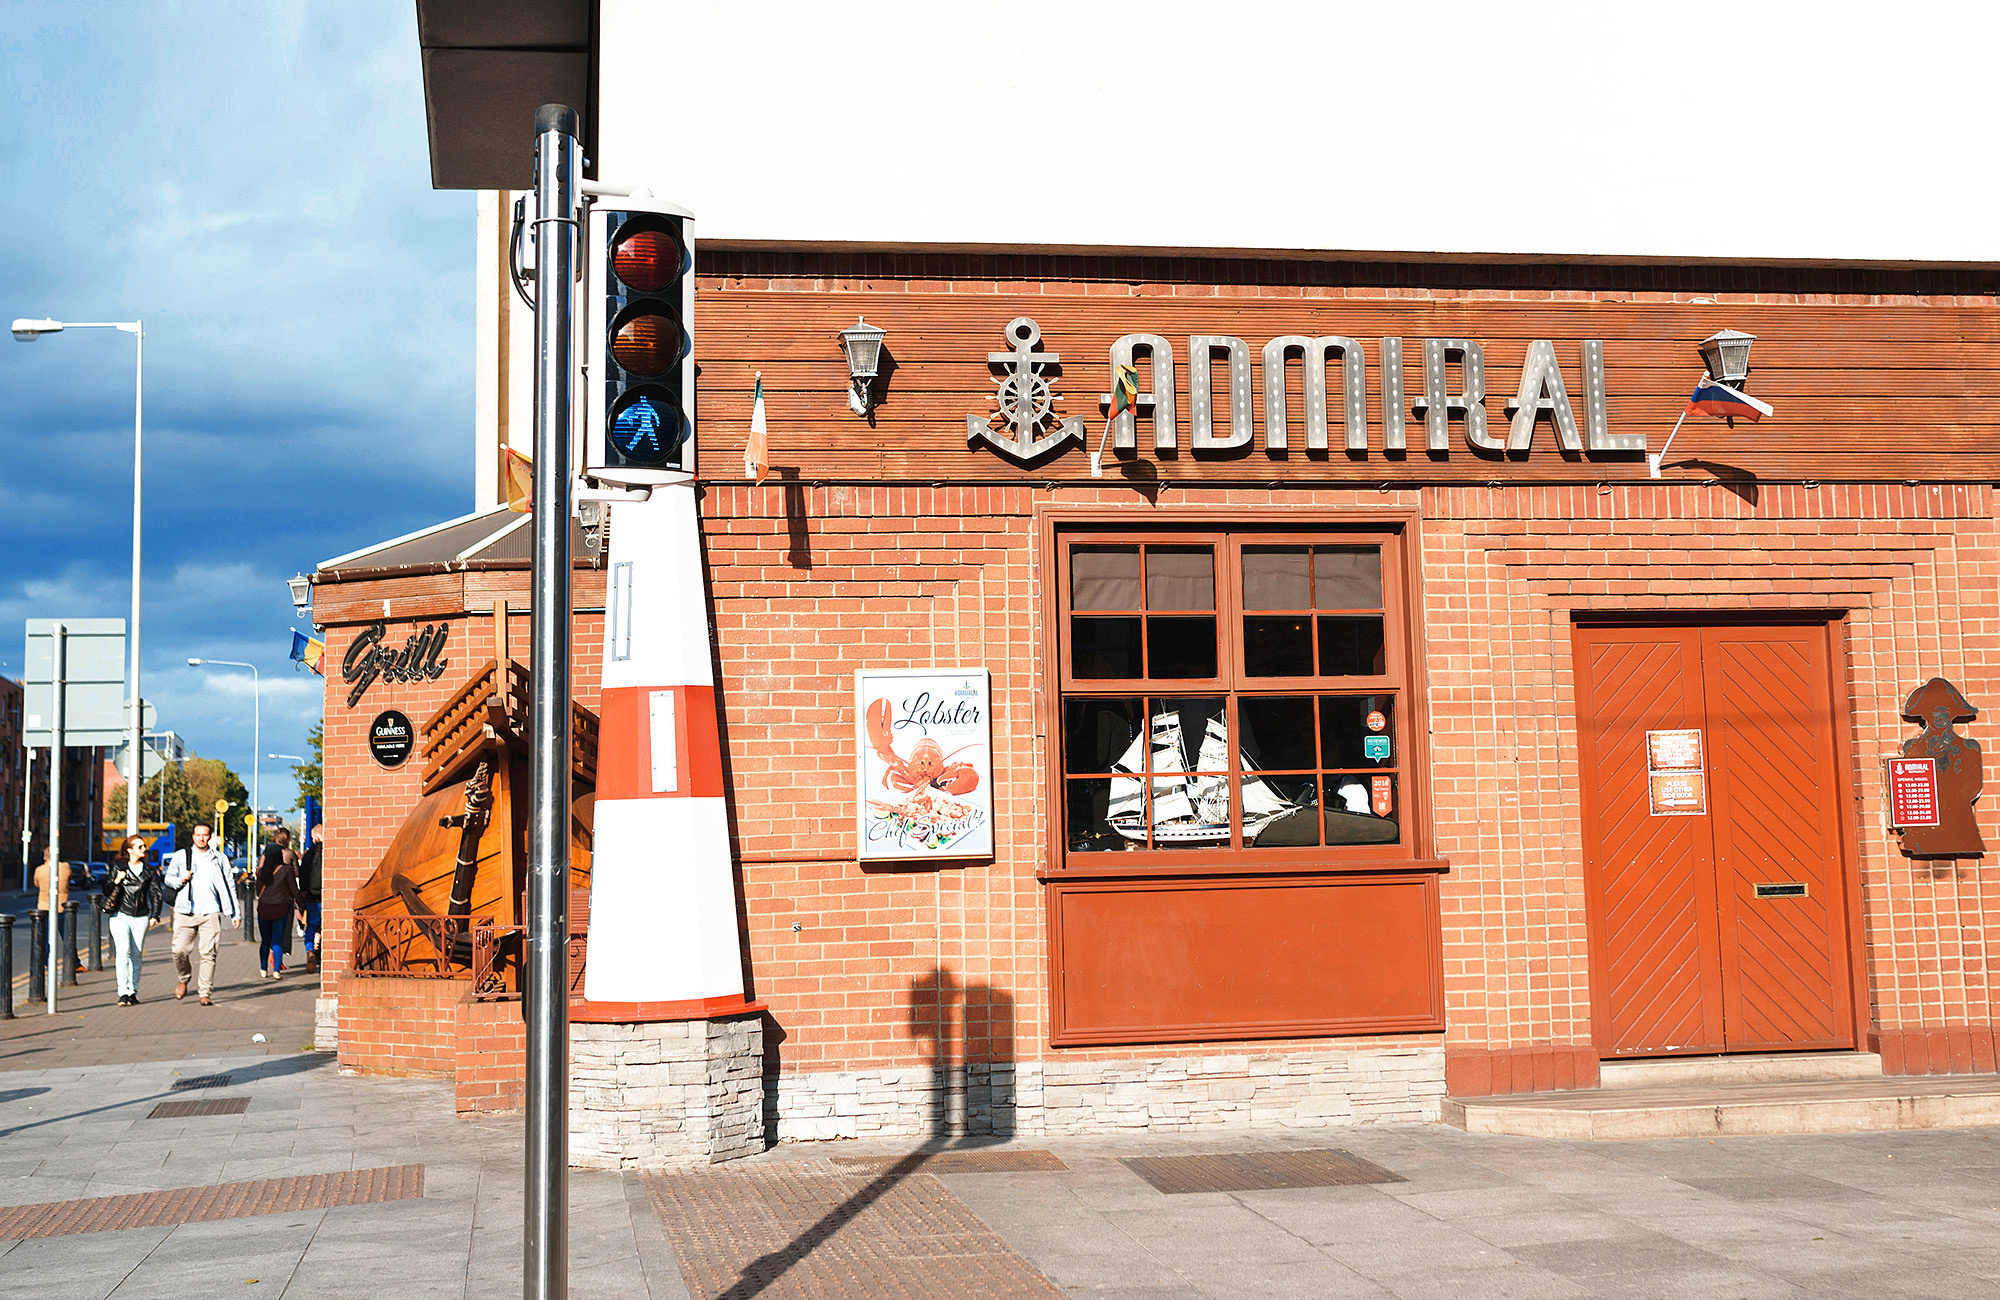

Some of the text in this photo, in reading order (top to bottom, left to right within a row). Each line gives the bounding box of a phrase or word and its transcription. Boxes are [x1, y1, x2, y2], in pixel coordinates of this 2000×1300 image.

[1100, 333, 1647, 452] ADMIRAL
[342, 622, 449, 709] Grill
[375, 726, 406, 736] GUINNESS
[894, 692, 982, 735] Lobster
[868, 816, 909, 848] Chef
